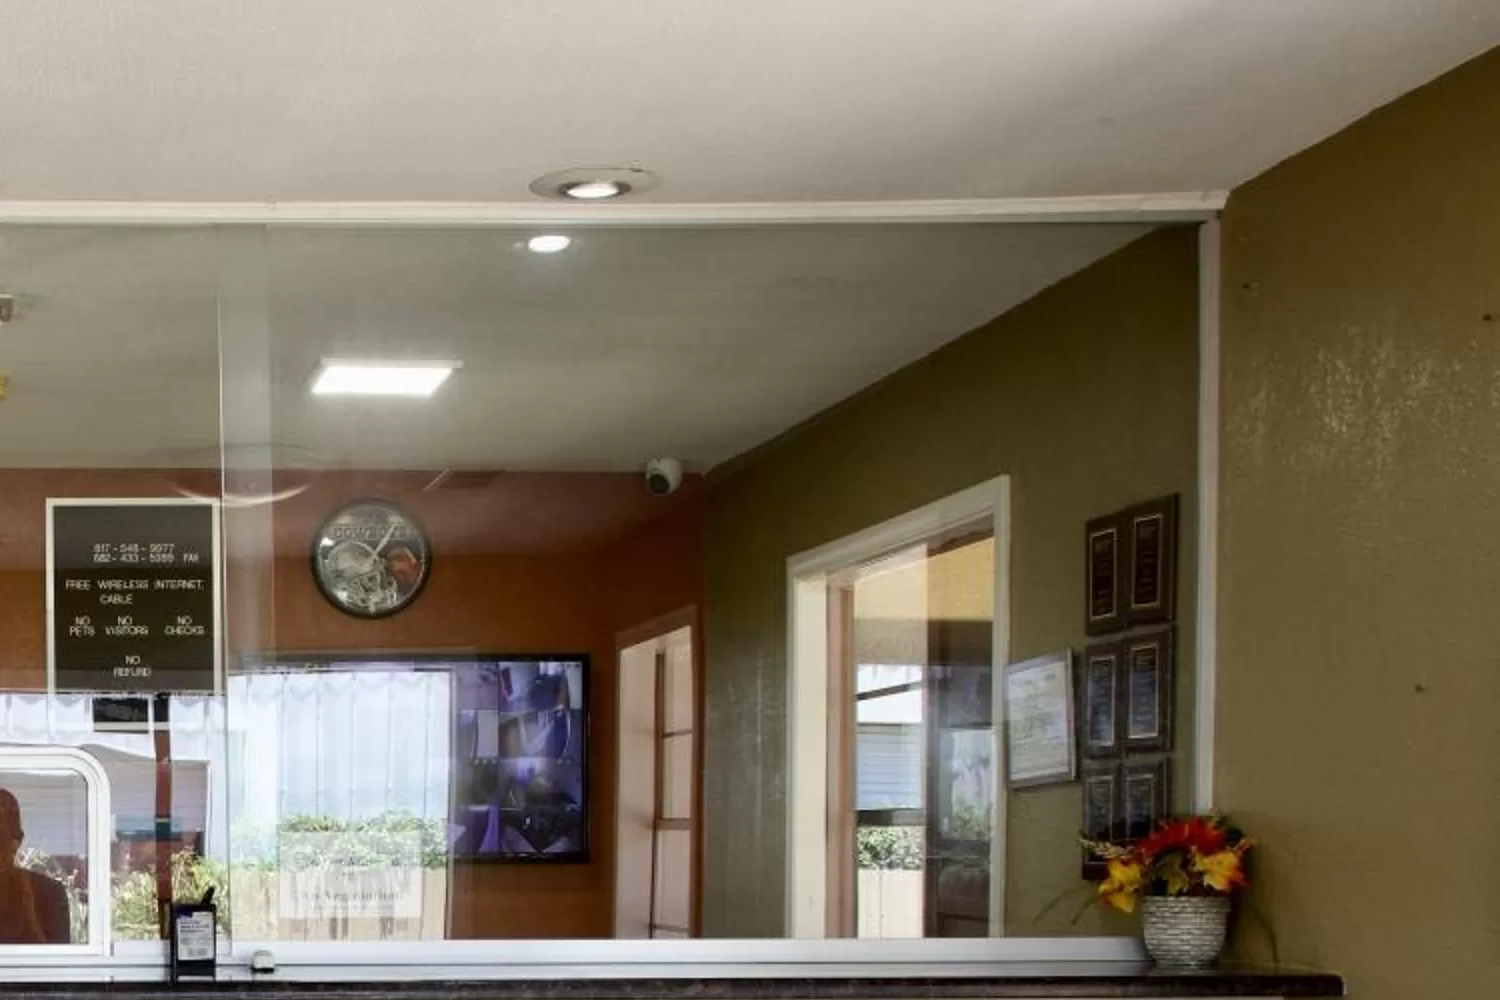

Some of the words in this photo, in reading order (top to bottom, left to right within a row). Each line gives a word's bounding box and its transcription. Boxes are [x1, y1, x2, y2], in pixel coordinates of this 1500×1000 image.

[66, 579, 91, 590] FREE
[97, 579, 149, 590] WIRELESS
[100, 594, 132, 604] CABLE
[75, 616, 90, 624] NO
[118, 615, 132, 624] NO
[177, 615, 192, 624] NO
[70, 626, 96, 636] PETS
[105, 625, 149, 636] VISITORS
[164, 625, 205, 636] CHECKS
[125, 656, 140, 665] NO
